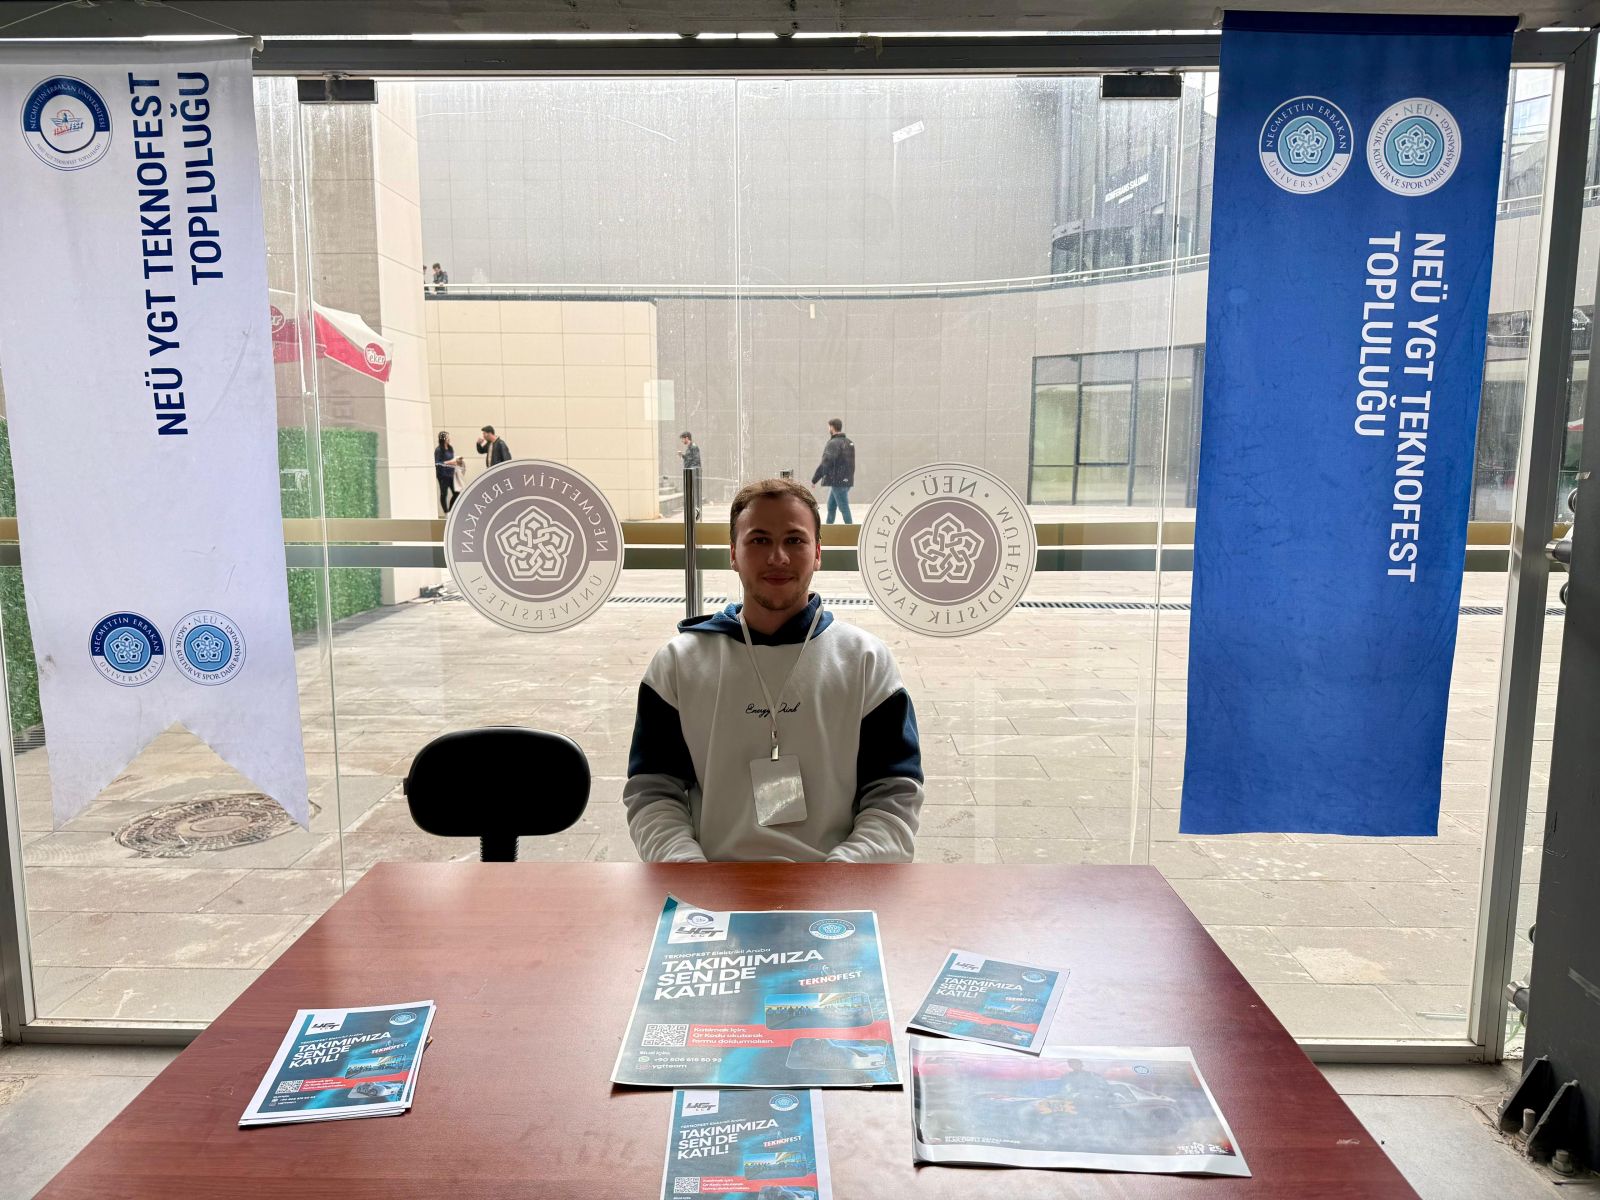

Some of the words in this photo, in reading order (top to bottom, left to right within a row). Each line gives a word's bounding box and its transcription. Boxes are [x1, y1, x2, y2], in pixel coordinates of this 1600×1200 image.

[1403, 103, 1434, 116] NEÜ
[1266, 102, 1314, 148] NECMETTİN
[1318, 105, 1347, 149] ERBAKAN
[128, 72, 174, 280] TEKNOFEST
[171, 71, 224, 285] TOPLULUĞU
[1390, 176, 1401, 187] VE
[1400, 181, 1424, 189] SPOR
[1411, 233, 1448, 304] NEÜ
[146, 289, 180, 356] YGT
[1354, 230, 1401, 437] TOPLULUĞU
[1402, 313, 1439, 382] YGT
[145, 367, 189, 436] NEÜ
[1387, 391, 1432, 583] TEKNOFEST
[94, 617, 130, 653] NECMETTİN
[133, 619, 161, 652] ERBAKAN
[202, 673, 221, 681] SPOR
[745, 703, 771, 718] Energy
[662, 949, 825, 973] TAKIMIMIZA
[657, 970, 714, 987] SEN
[719, 967, 757, 981] DE
[798, 970, 863, 987] TEKNOFEST
[943, 977, 1024, 991] TAKIMIMIZA
[653, 981, 741, 1001] KATIL!
[939, 983, 969, 991] SEN
[968, 985, 989, 994] DE
[298, 1031, 393, 1053] TAKIMIMIZA
[288, 1053, 340, 1069] KATIL!
[293, 1049, 328, 1061] SEN
[328, 1044, 352, 1055] DE
[679, 1118, 779, 1140] TAKIMIMIZA
[678, 1135, 715, 1150] SEN
[715, 1133, 739, 1145] DE
[763, 1135, 802, 1148] TEKNOFEST
[677, 1144, 729, 1160] KATIL!
